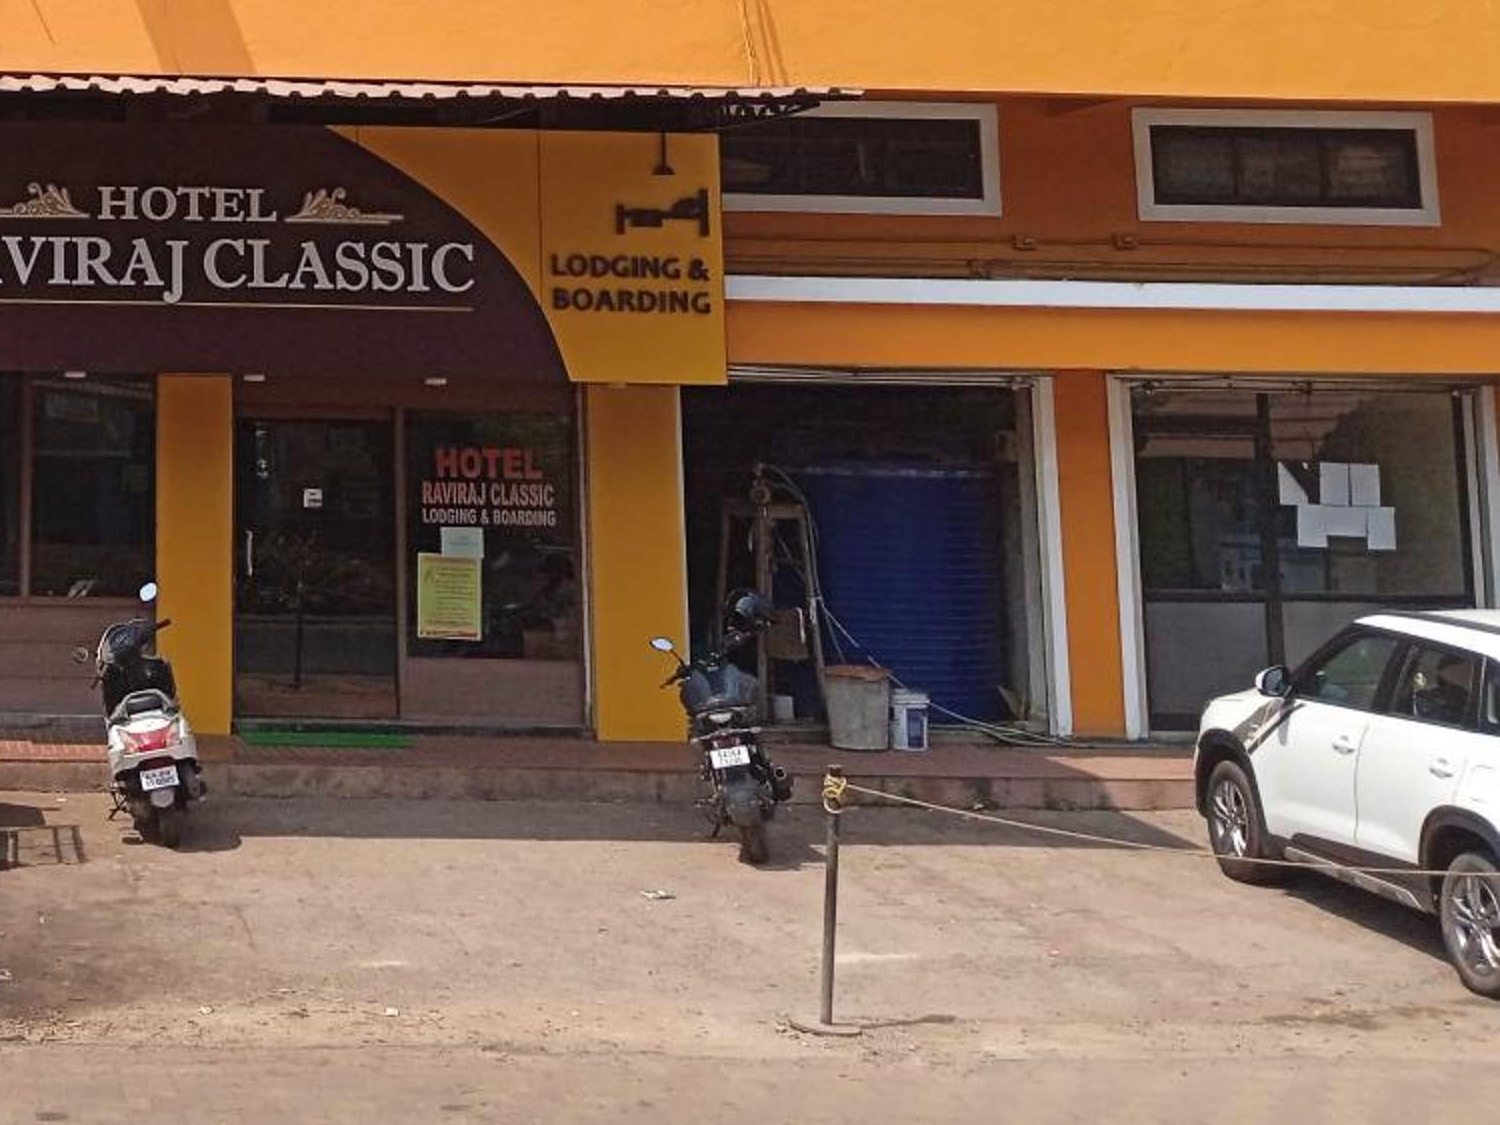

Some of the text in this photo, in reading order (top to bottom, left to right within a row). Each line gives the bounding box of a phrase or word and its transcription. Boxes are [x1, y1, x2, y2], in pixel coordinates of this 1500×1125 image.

[97, 186, 277, 222] HOTEL
[203, 238, 475, 293] CLASSIC
[550, 254, 711, 282] LODGING &
[552, 287, 712, 314] BOARDING
[435, 447, 543, 479] HOTEL
[422, 482, 555, 507] RAVIRAJ CLASSIC
[422, 508, 556, 526] LODGING & BOARDING
